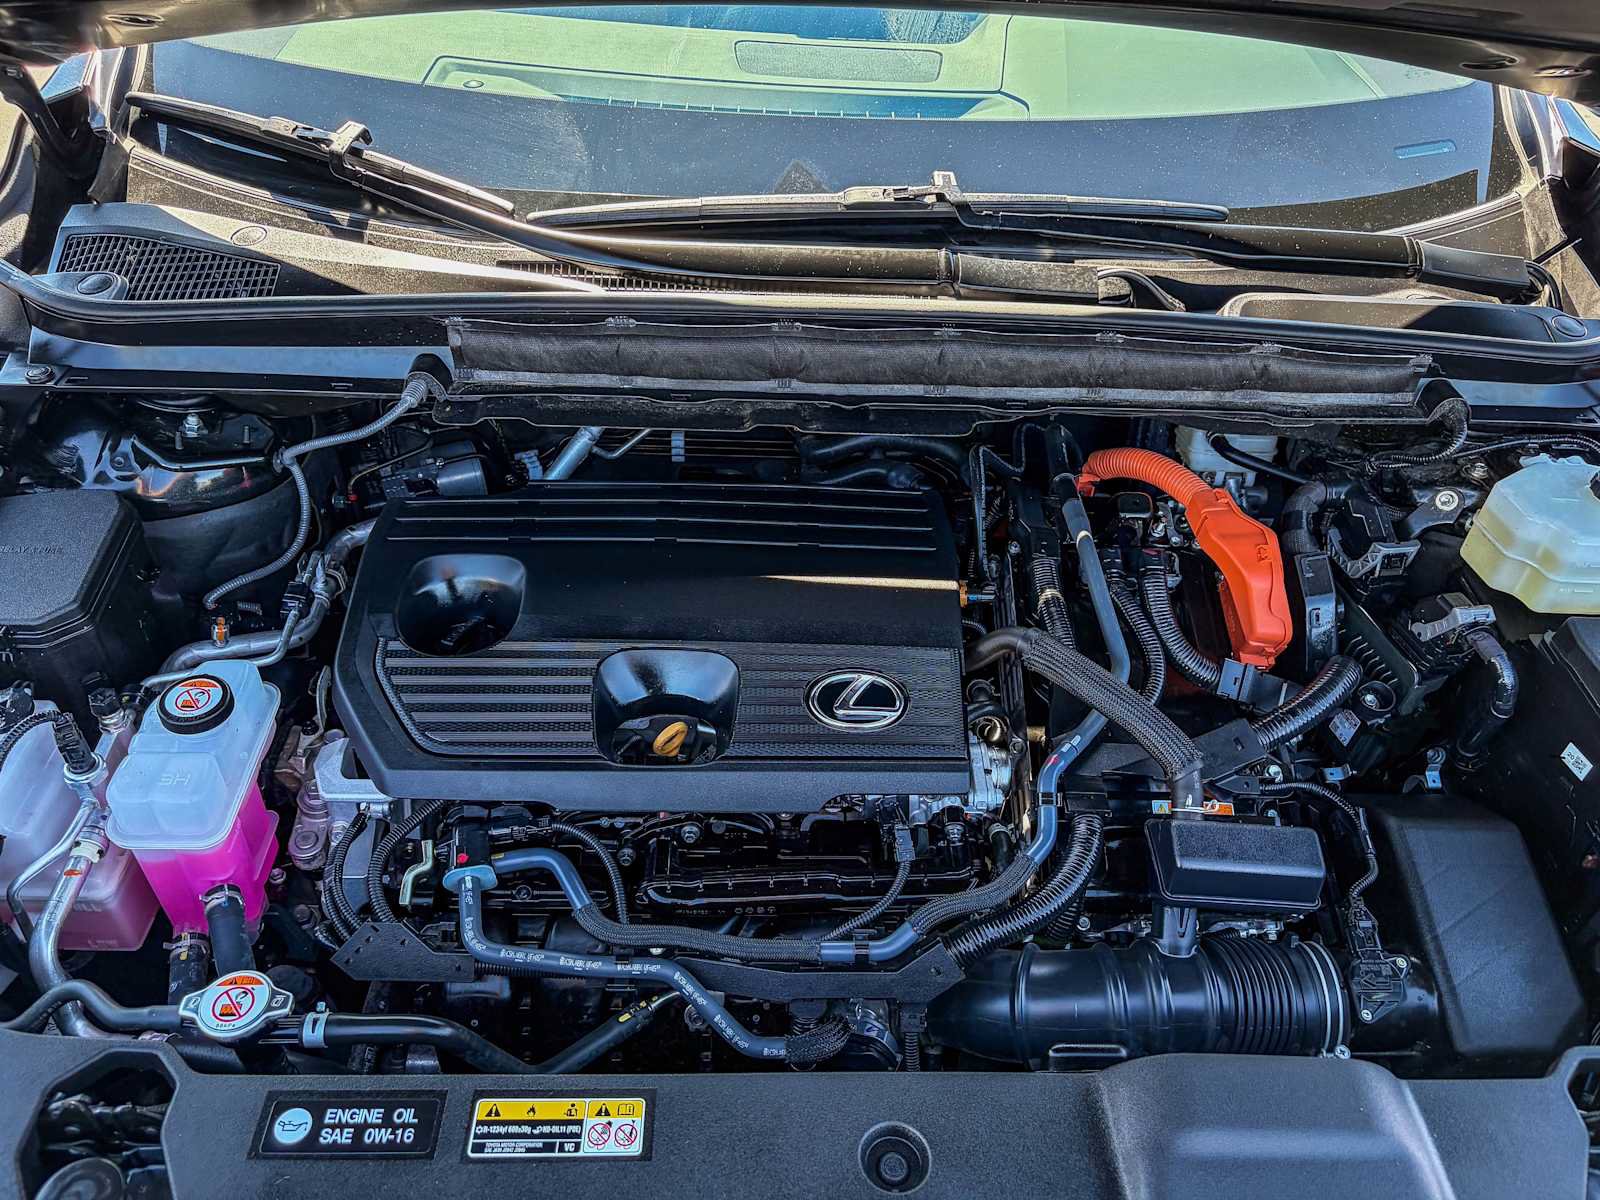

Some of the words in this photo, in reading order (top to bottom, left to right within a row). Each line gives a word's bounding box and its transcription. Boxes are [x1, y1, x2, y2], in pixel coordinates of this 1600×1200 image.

[324, 1108, 385, 1124] ENGINE
[393, 1108, 418, 1124] OIL
[319, 1127, 355, 1144] SAE
[364, 1127, 415, 1144] 0W-16
